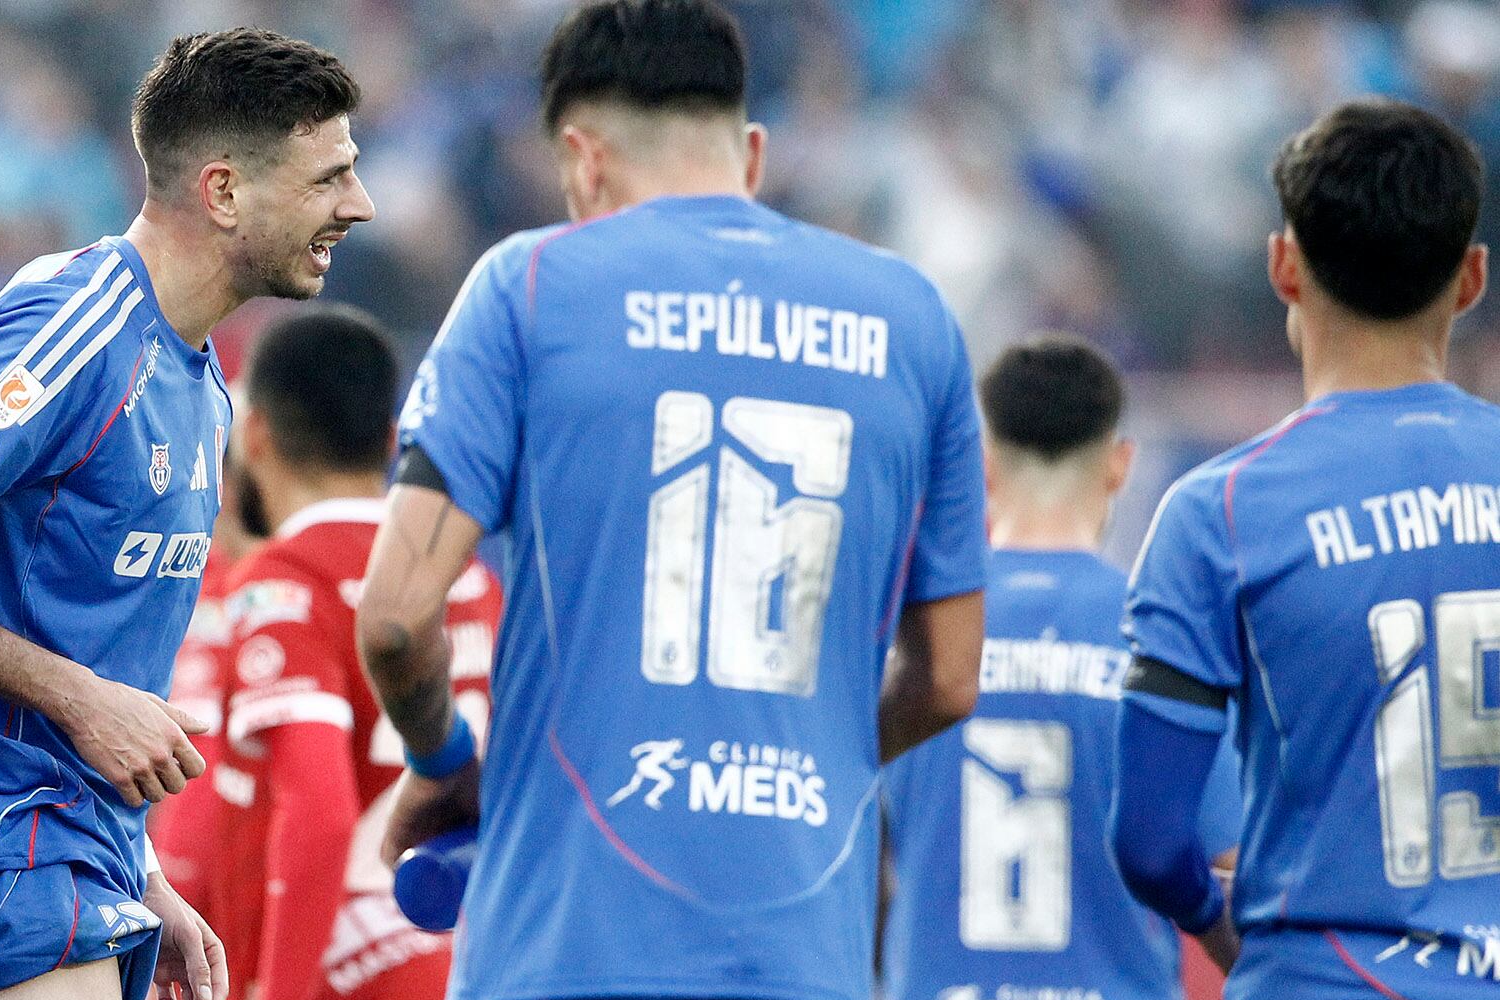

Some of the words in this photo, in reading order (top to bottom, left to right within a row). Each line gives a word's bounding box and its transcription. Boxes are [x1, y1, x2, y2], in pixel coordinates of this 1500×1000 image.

[625, 279, 889, 379] SEPÚLVEDA
[640, 389, 855, 699] 16
[1306, 482, 1500, 569] ALTAMIR
[688, 761, 828, 827] MEDS
[960, 717, 1073, 951] 6
